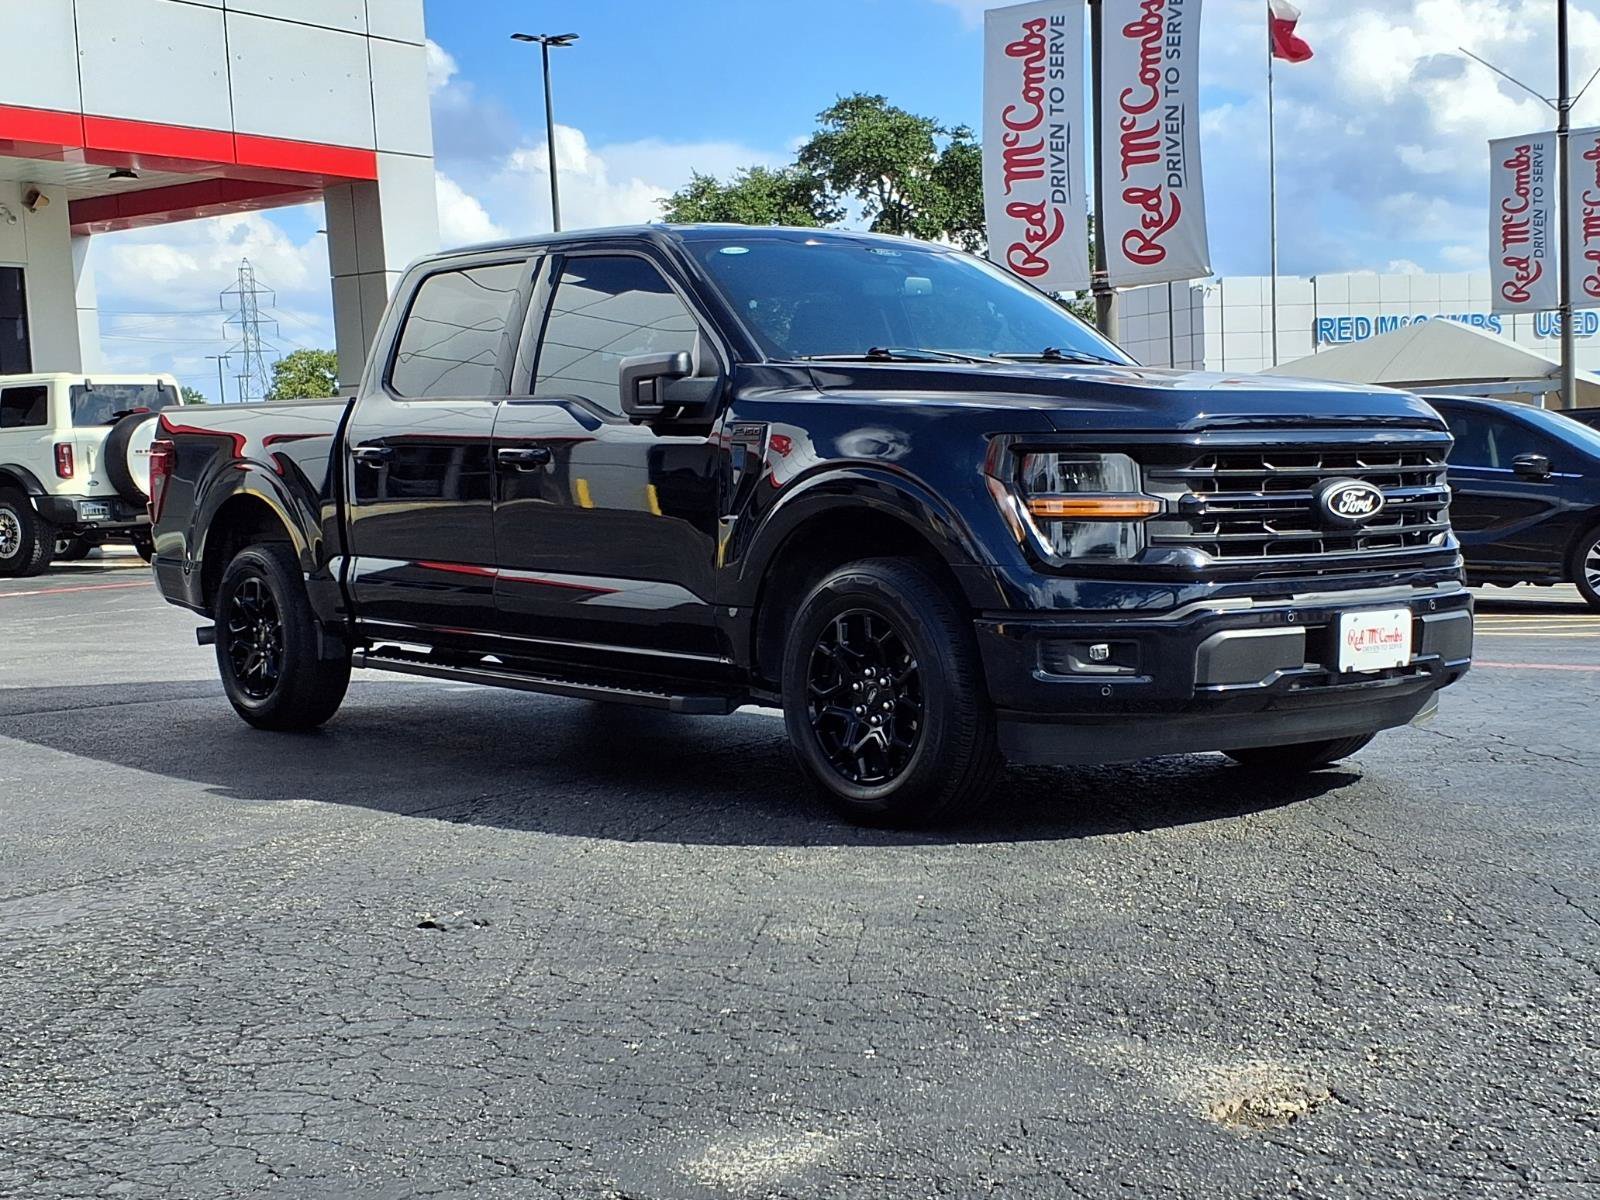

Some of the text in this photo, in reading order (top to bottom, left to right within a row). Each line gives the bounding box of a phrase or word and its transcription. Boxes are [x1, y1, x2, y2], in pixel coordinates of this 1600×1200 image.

[1049, 15, 1067, 204] DRIVEN TO SERVE
[1164, 67, 1180, 98] TO
[1002, 17, 1065, 277] Red McCombs
[1119, 0, 1181, 265] Red McCombs
[1165, 105, 1183, 188] DRIVEN
[1502, 144, 1543, 303] Red McCombs
[1533, 143, 1545, 258] DRIVEN TO SERVE
[1318, 315, 1371, 342] RED
[1338, 490, 1373, 513] Ford
[1347, 628, 1365, 651] Red
